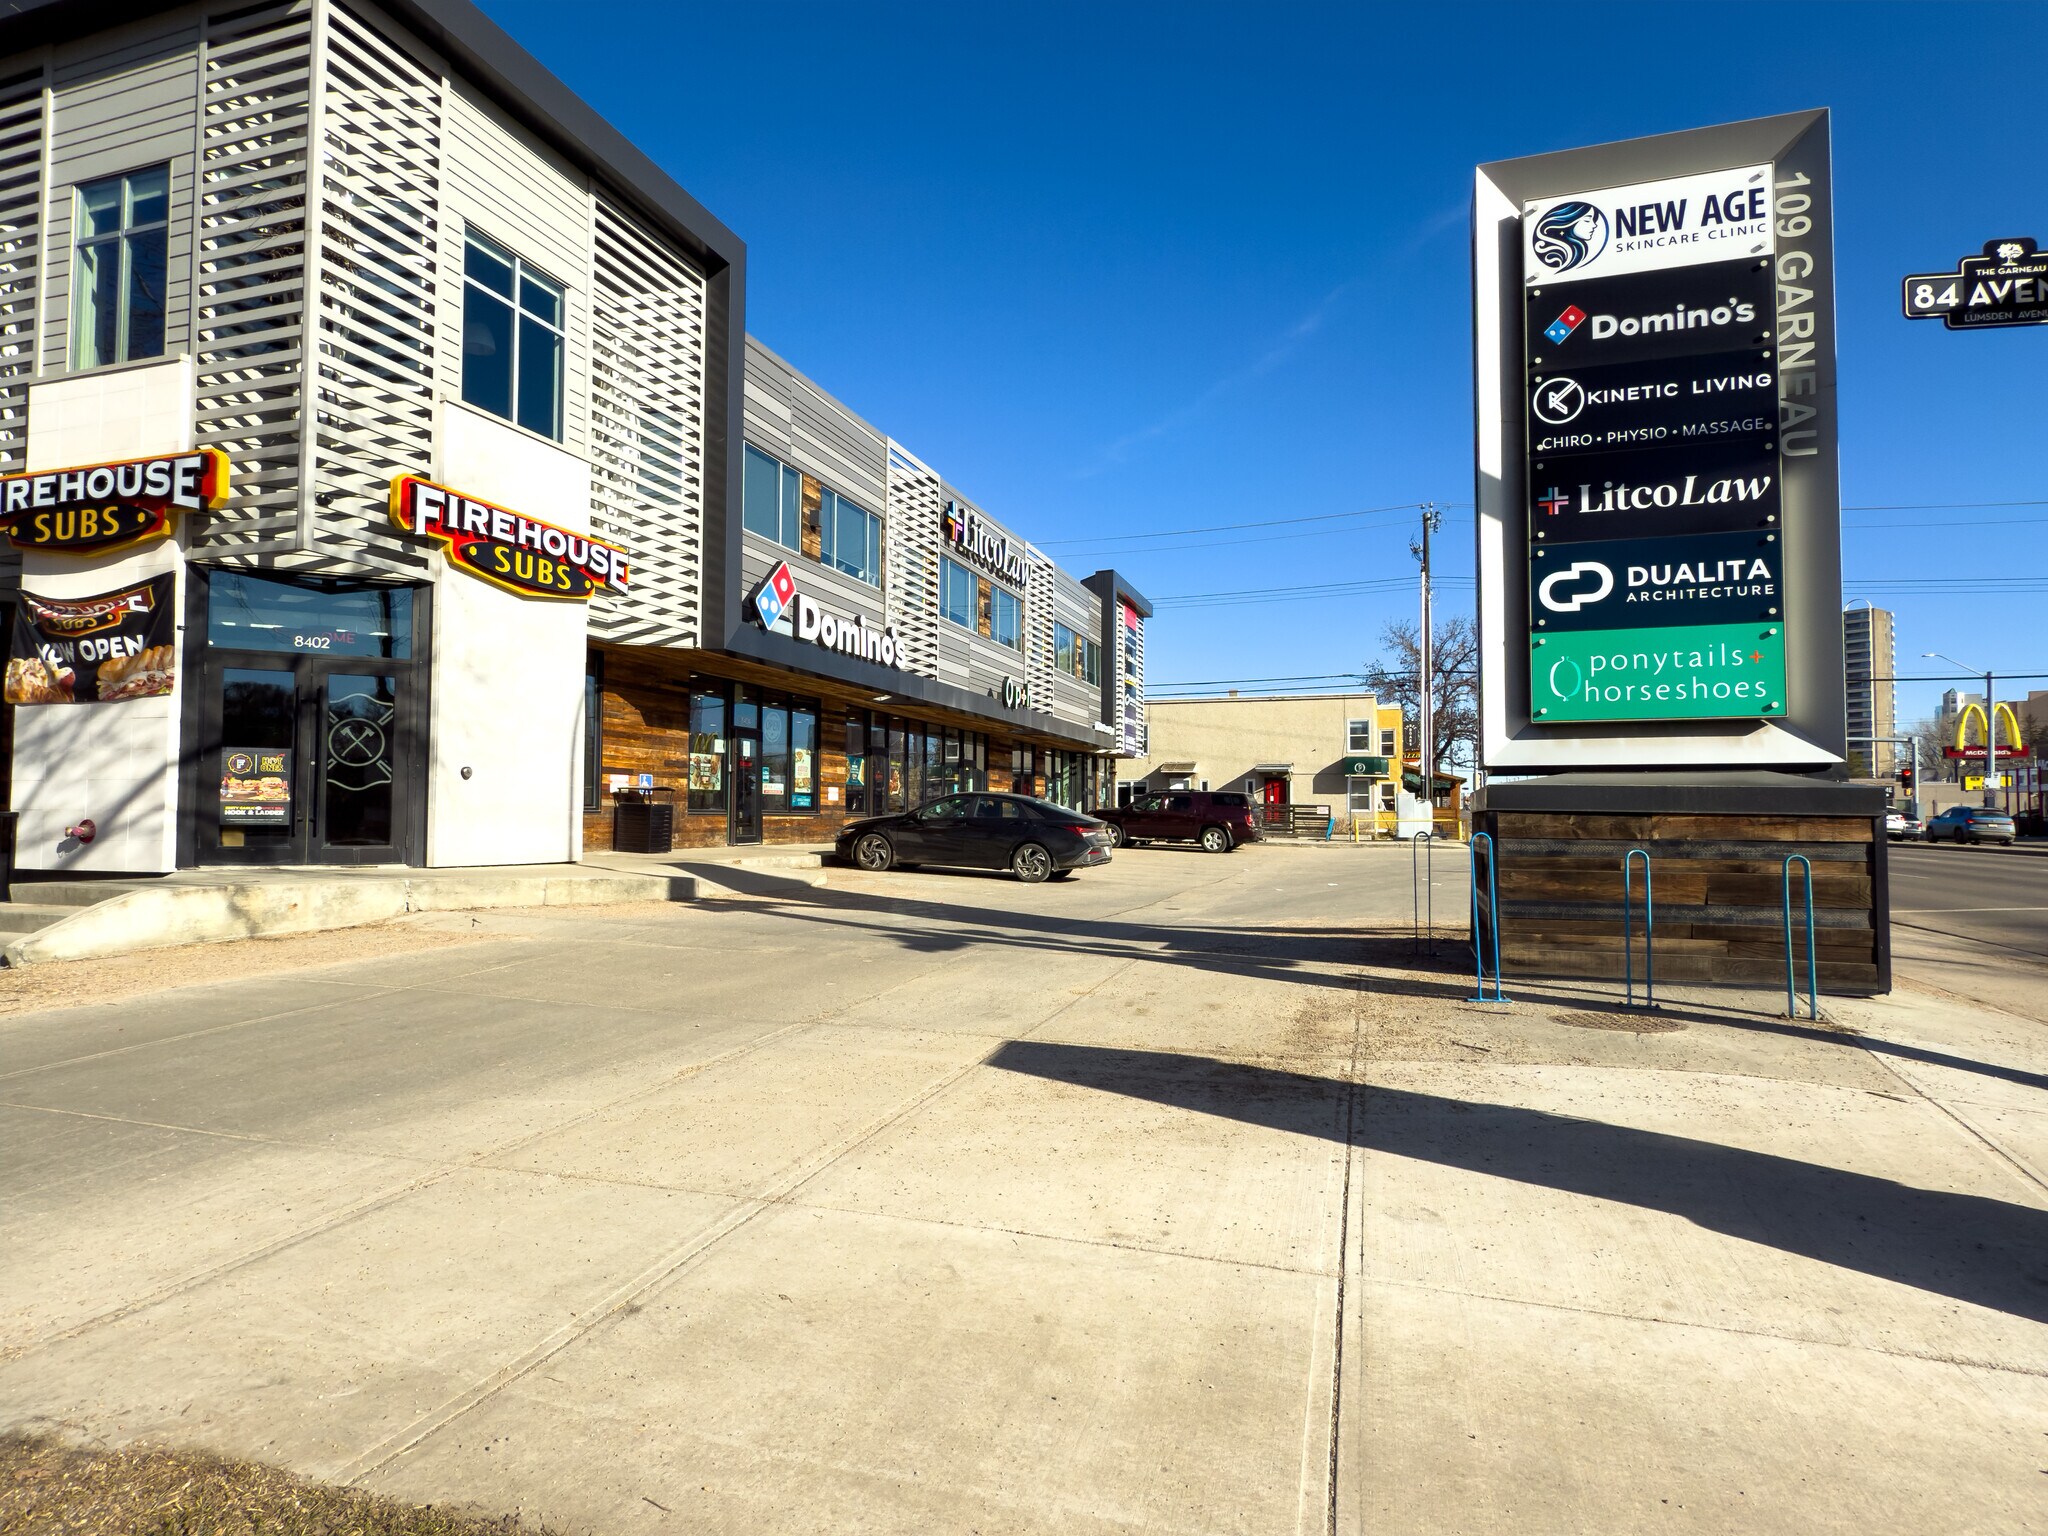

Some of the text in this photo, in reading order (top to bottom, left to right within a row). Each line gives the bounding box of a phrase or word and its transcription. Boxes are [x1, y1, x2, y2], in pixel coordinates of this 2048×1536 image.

[1615, 187, 1767, 239] NEW AGE
[1616, 222, 1767, 253] SKINCARE CLINIC
[1975, 265, 2047, 276] THE GARNEAU
[1914, 282, 1960, 309] 84
[1592, 297, 1756, 341] Domino's
[1775, 171, 1818, 457] 109 GARNEAU
[1964, 311, 2013, 322] LUMSDEN
[1587, 373, 1773, 405] KINETIC LIVING
[1542, 417, 1765, 450] CHIRO PHYSIO MASSAGE
[0, 455, 201, 514] REHOUSE
[1578, 474, 1772, 514] LitcoLaw
[34, 506, 120, 543] SUBS
[414, 482, 629, 596] FIREHOUSE
[963, 508, 1033, 585] LitcoLaw
[493, 546, 572, 590] SUBS
[1626, 558, 1772, 587] DUALITA
[1626, 584, 1775, 602] ARCHITECTURE
[79, 634, 144, 661] OPEN
[294, 635, 331, 649] 8402
[798, 593, 908, 670] Domino's
[1590, 643, 1744, 676] ponytails
[1585, 677, 1767, 702] horseshoes
